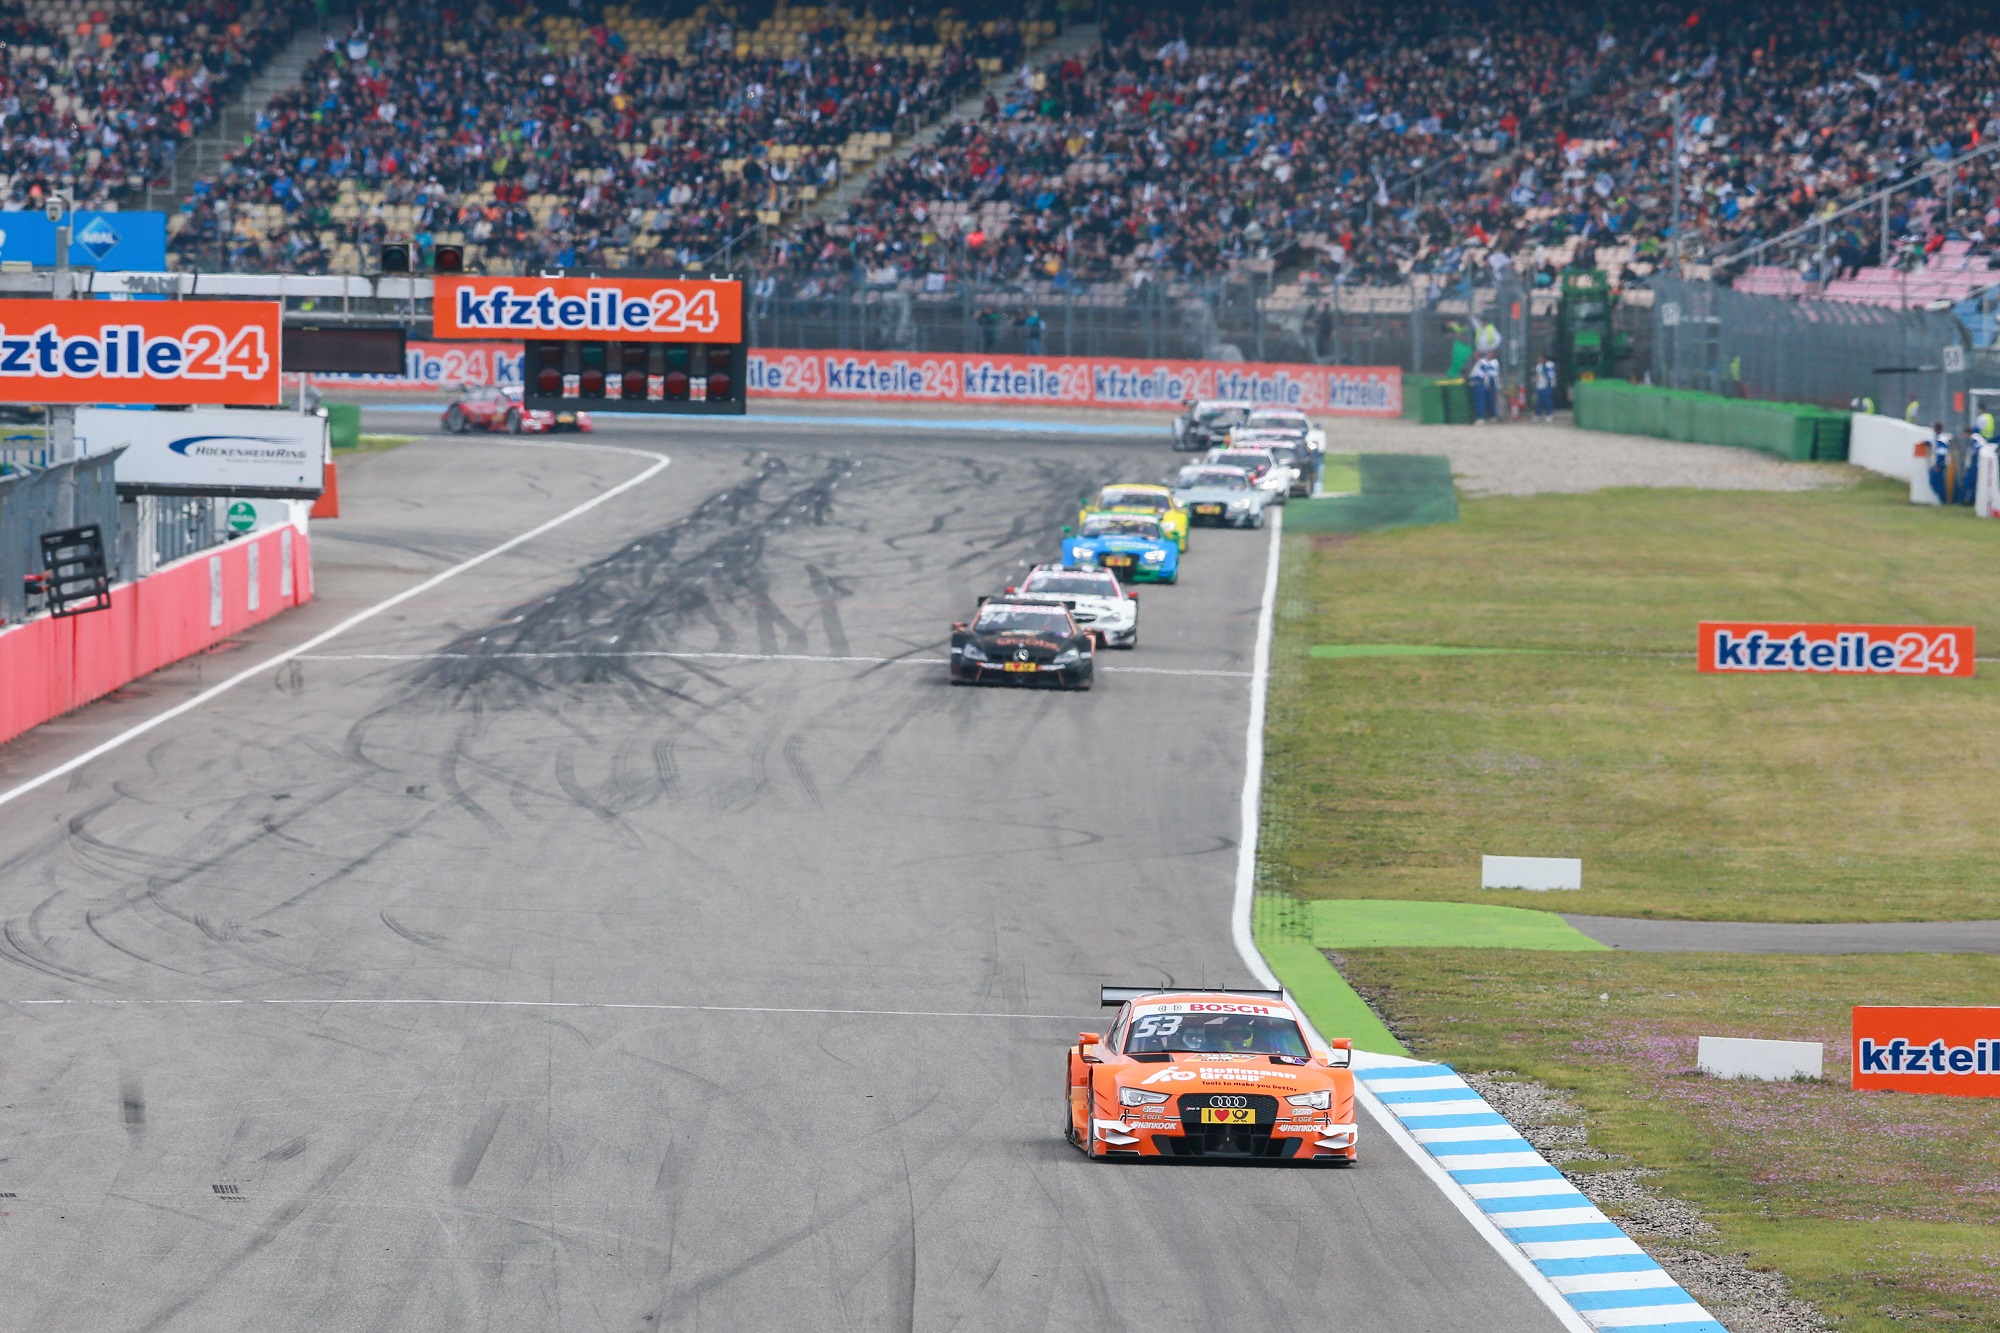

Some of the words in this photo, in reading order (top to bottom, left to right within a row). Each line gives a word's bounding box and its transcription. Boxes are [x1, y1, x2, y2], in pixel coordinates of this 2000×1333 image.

[456, 286, 719, 332] kfzteile24
[0, 324, 269, 380] zteile24
[824, 356, 959, 397] kfzteile24
[962, 359, 1091, 401] kfzteile24
[1092, 364, 1213, 404] kfzteile24
[1714, 629, 1959, 673] kfzteile24
[1135, 1016, 1183, 1037] 53
[1190, 1003, 1269, 1014] BOSCH
[1199, 1067, 1297, 1080] Hoffmann
[1272, 1084, 1298, 1092] better
